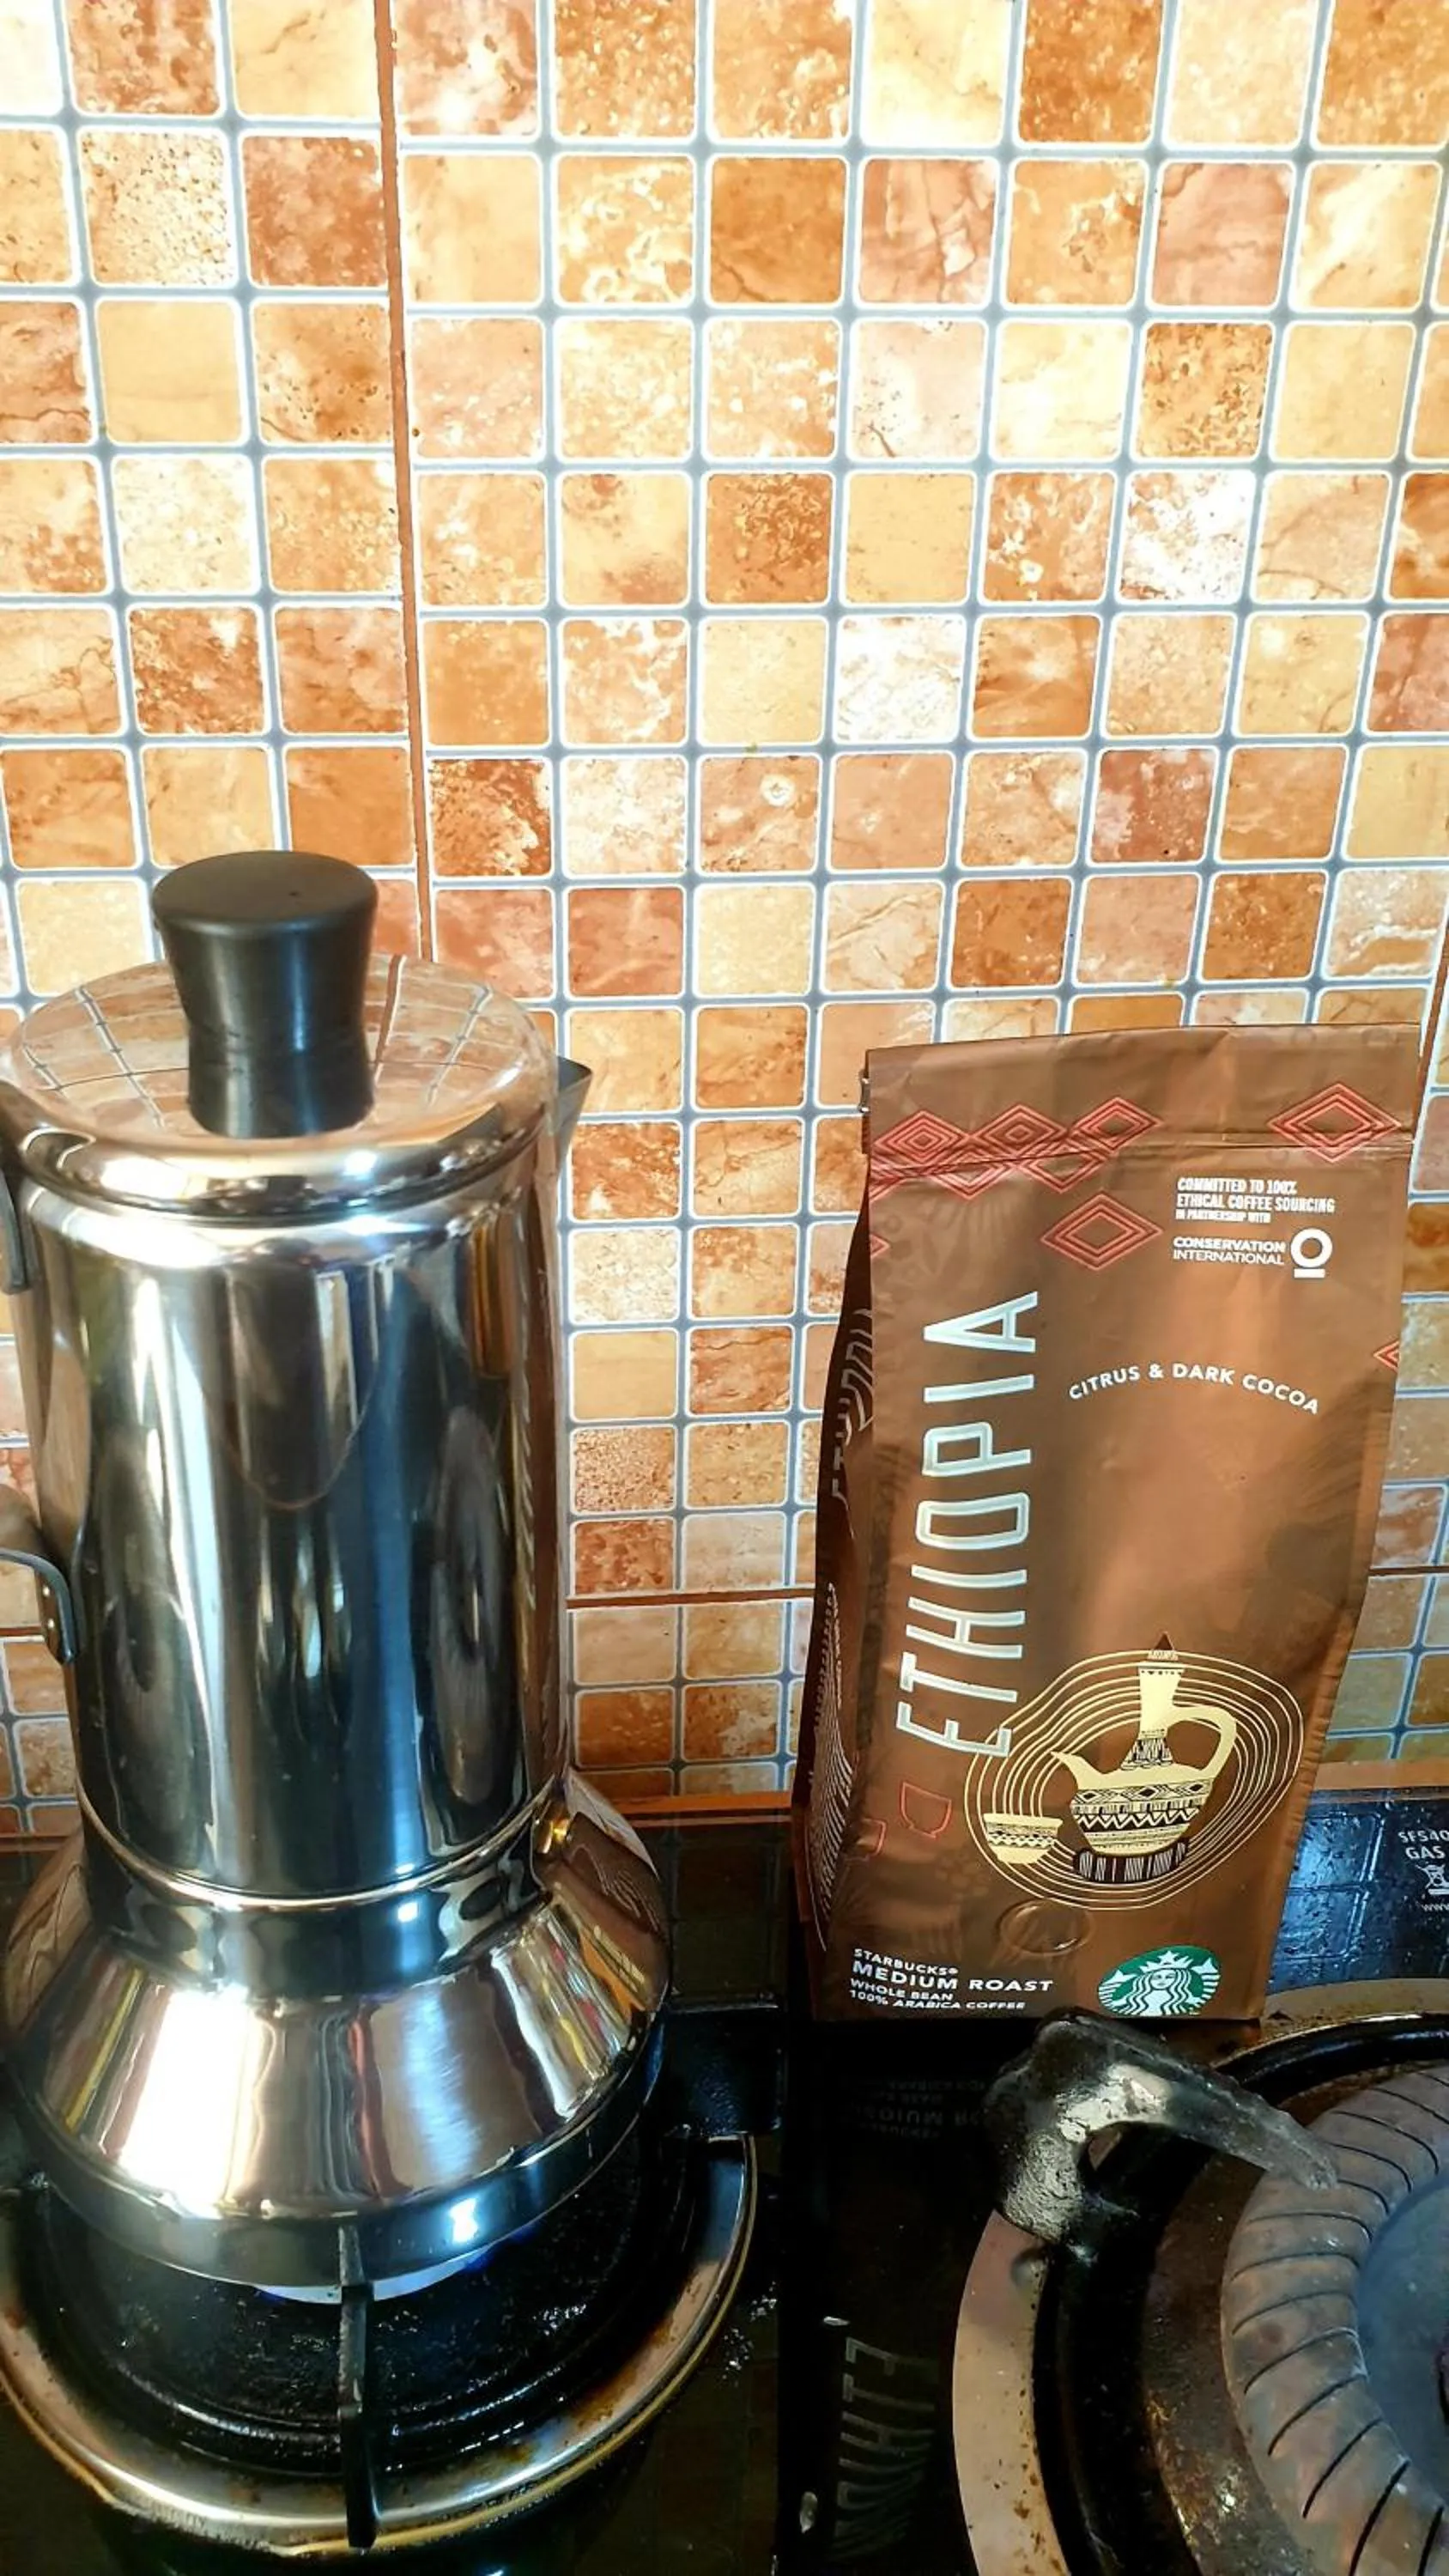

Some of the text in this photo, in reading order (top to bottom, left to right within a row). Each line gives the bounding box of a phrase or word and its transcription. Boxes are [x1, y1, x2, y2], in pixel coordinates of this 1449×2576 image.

[1177, 1177, 1298, 1194] COMMITTED TO 100%
[1176, 1193, 1336, 1212] ETHICAL COFFEE SOURCING
[1175, 1209, 1271, 1224] IN PARTNERSHIP WITH
[1173, 1236, 1286, 1253] CONSERVATION
[1173, 1250, 1285, 1266] INTERNATIONAL
[1069, 1363, 1319, 1415] CITRUS & DARK COCOA
[896, 1291, 1039, 1758] ETHIOPIA
[1405, 1845, 1446, 1860] GAS
[852, 1960, 1053, 1991] MEDIUM ROAST
[850, 1978, 953, 2001] WHOLE BEAN
[850, 1989, 889, 2006] 100%
[893, 1999, 961, 2009] ARABICA
